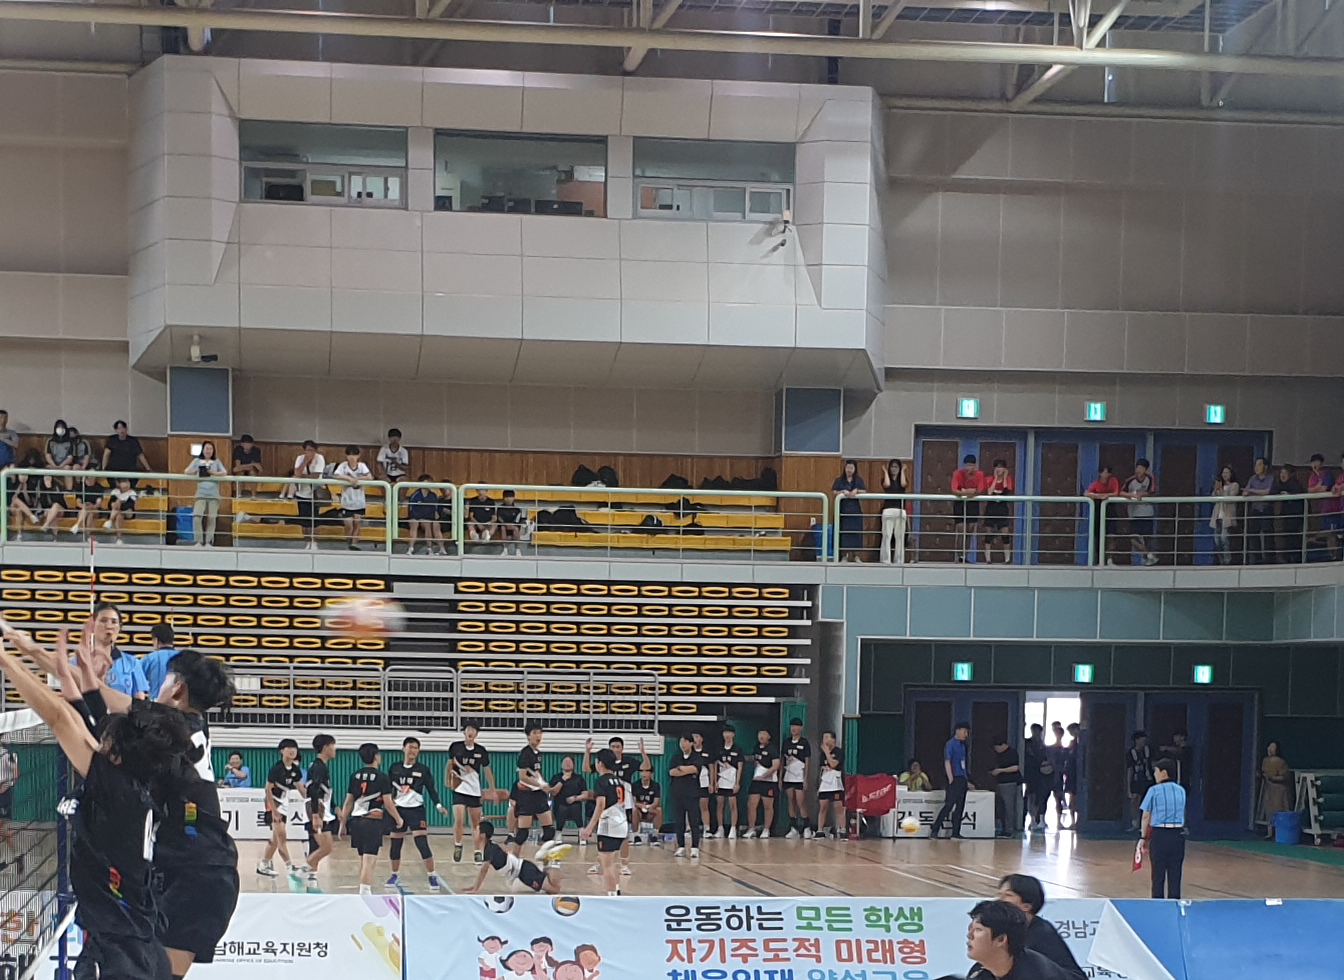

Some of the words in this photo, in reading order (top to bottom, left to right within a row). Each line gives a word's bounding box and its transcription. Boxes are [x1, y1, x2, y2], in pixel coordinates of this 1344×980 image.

[664, 905, 784, 932] 운동하는
[795, 905, 853, 932] 모든
[863, 905, 924, 933] 학생
[665, 938, 822, 964] 자기주도적
[834, 938, 927, 965] 미래형
